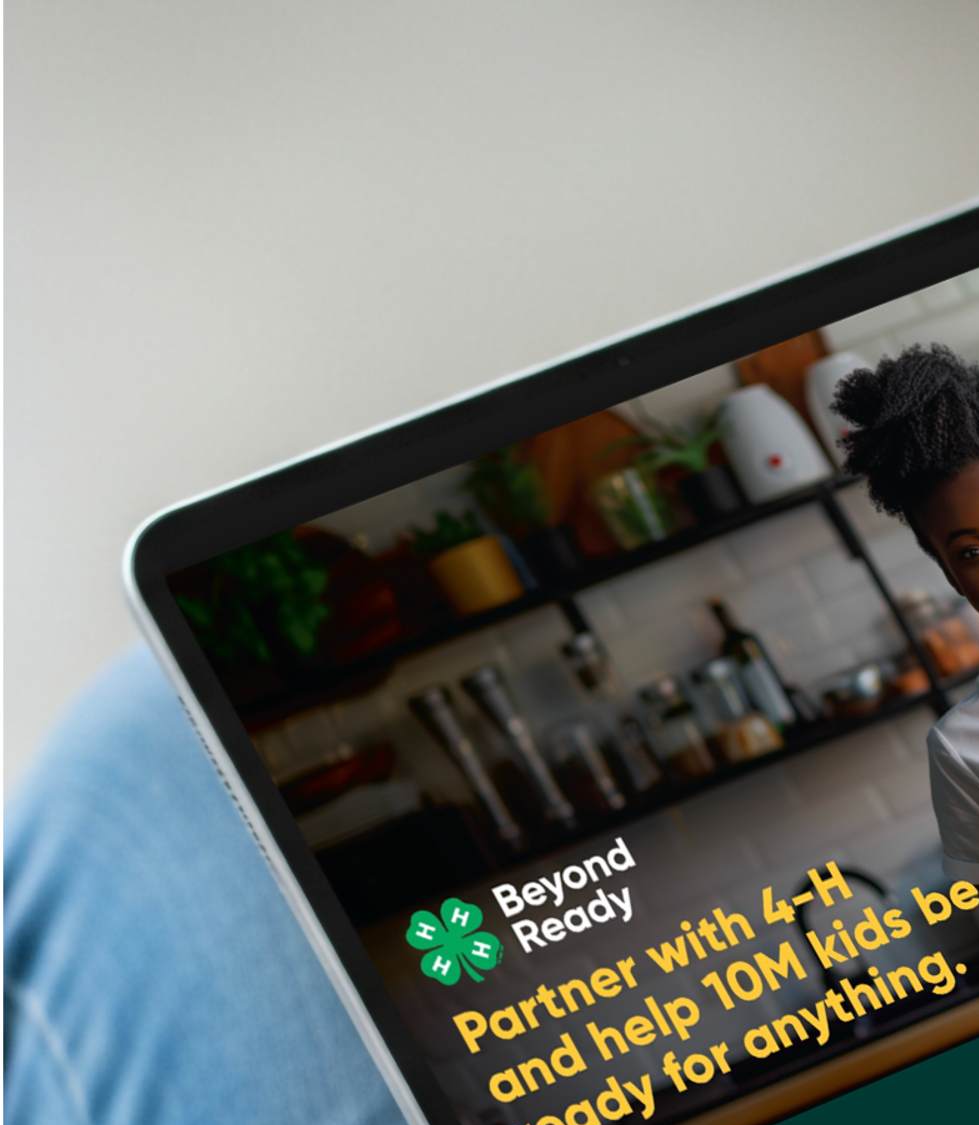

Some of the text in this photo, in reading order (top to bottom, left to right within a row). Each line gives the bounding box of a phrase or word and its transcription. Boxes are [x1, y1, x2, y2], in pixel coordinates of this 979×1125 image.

[492, 837, 636, 917] Beyond
[415, 907, 470, 941] H H
[432, 955, 452, 976] H
[471, 940, 492, 959] H
[453, 861, 853, 1053] Partner with 4-H
[511, 887, 632, 953] Ready
[489, 880, 979, 1102] and help 10M kids be
[662, 1042, 731, 1092] for
[744, 952, 967, 1058] anything.
